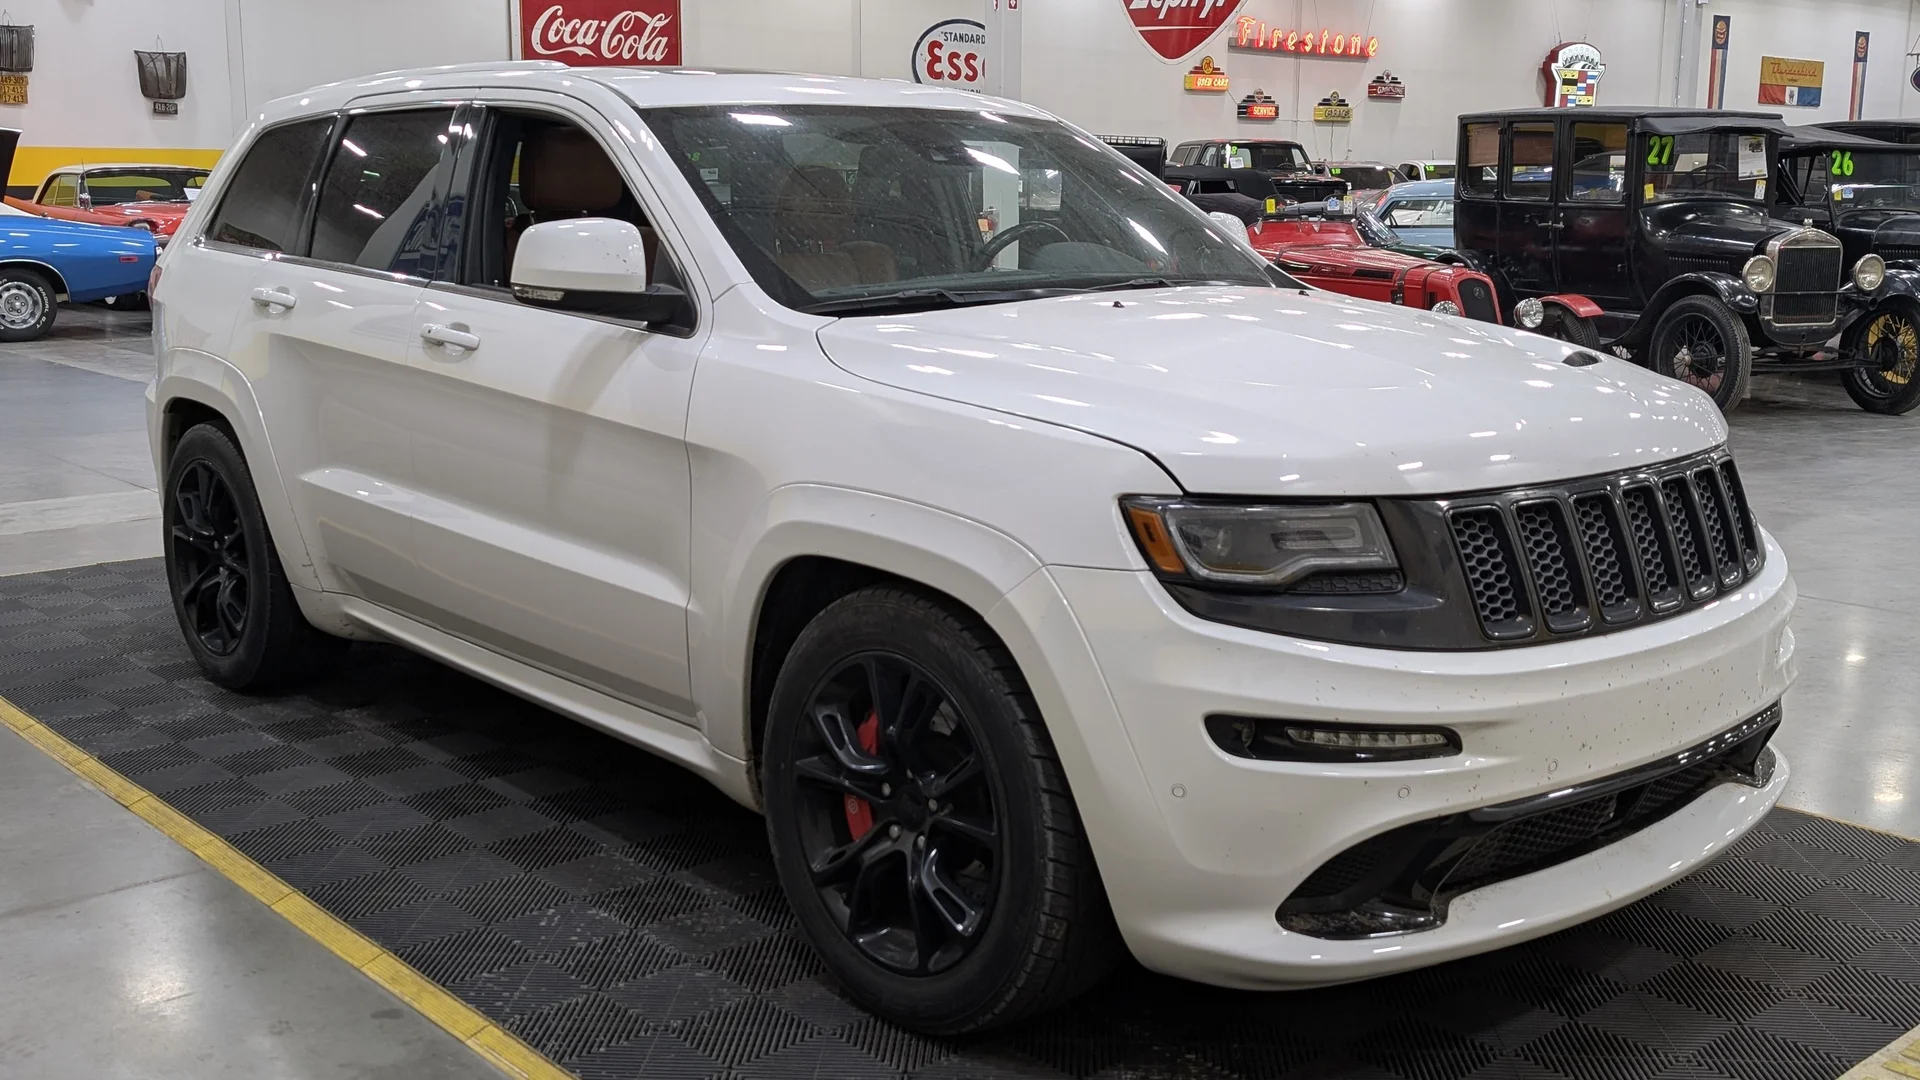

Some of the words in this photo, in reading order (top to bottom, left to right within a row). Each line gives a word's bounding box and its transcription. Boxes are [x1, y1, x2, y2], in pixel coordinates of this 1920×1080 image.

[531, 5, 673, 62] Coca-Cola
[1236, 16, 1379, 57] Firestone
[927, 40, 985, 82] Ess
[1770, 62, 1818, 77] Thunderbird
[1197, 78, 1212, 87] USED
[1253, 106, 1276, 115] SERVICE
[1647, 135, 1674, 165] 27
[1831, 149, 1854, 176] 26
